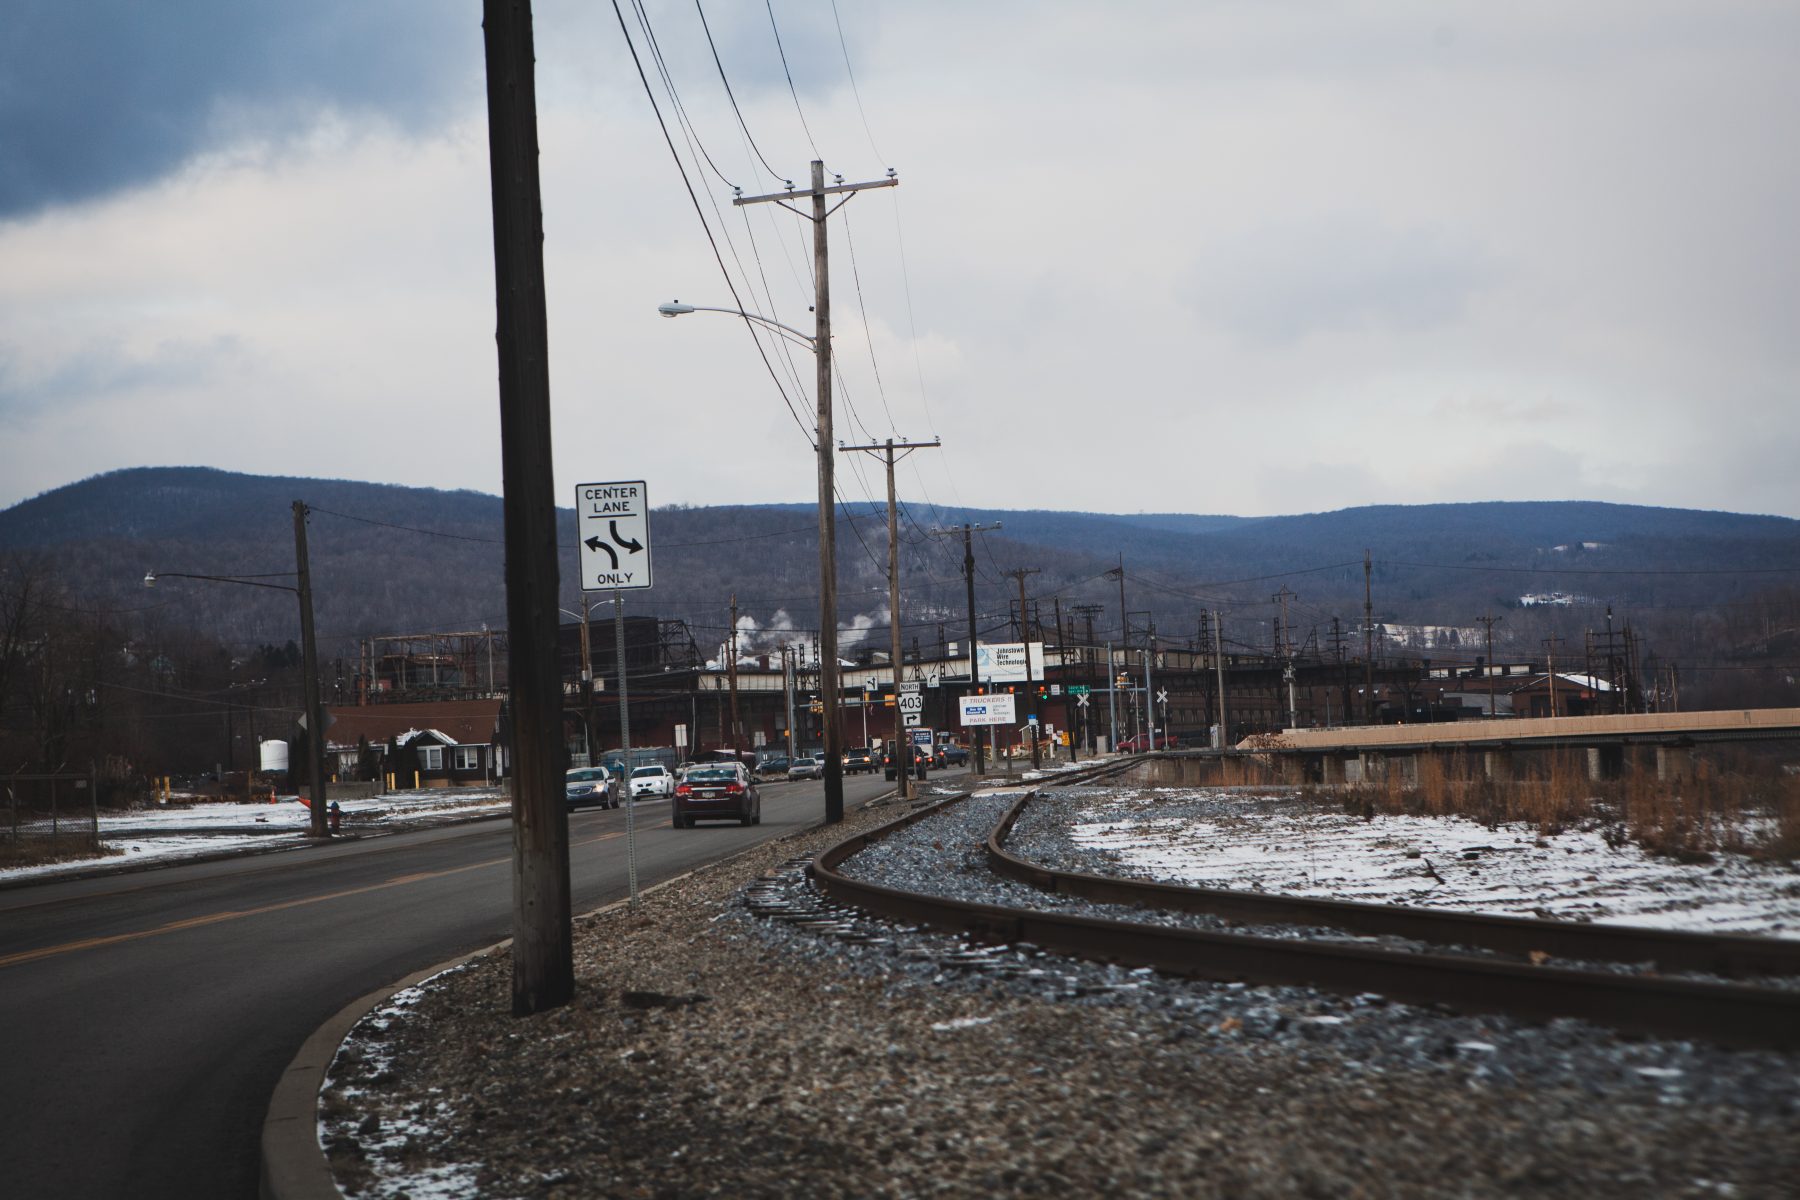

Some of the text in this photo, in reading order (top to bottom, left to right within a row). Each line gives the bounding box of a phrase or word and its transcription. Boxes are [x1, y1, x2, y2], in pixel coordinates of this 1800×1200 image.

[585, 487, 638, 500] CENTER
[594, 501, 630, 513] LANE
[597, 572, 633, 584] ONLY
[900, 683, 919, 691] NORTH
[900, 697, 922, 709] 403
